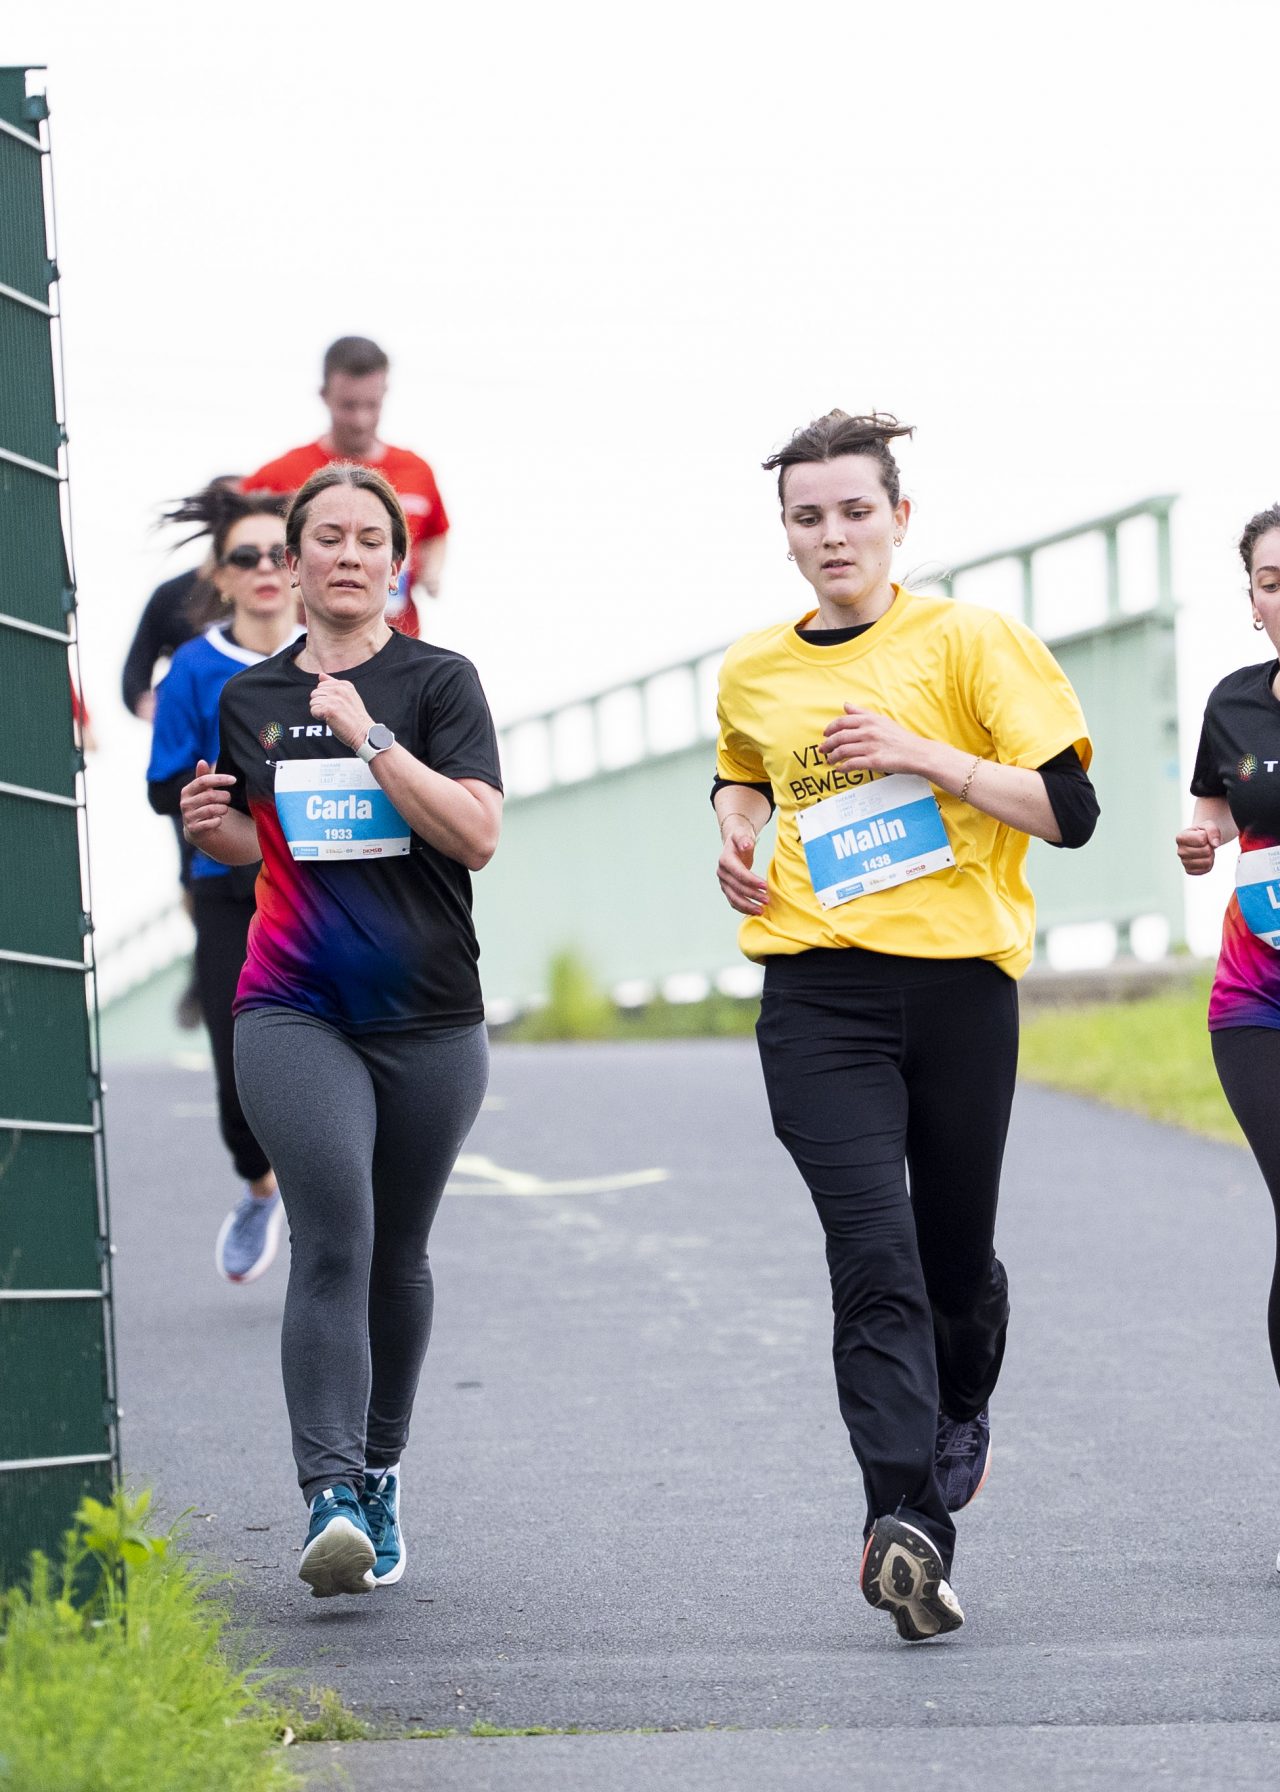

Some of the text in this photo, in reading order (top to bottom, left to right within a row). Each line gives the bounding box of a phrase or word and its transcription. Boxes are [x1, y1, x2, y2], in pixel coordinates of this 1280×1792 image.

[793, 744, 828, 769] VI
[306, 794, 372, 820] Carla
[324, 828, 353, 840] 1933
[832, 818, 907, 860] Malin
[862, 854, 892, 872] 1438
